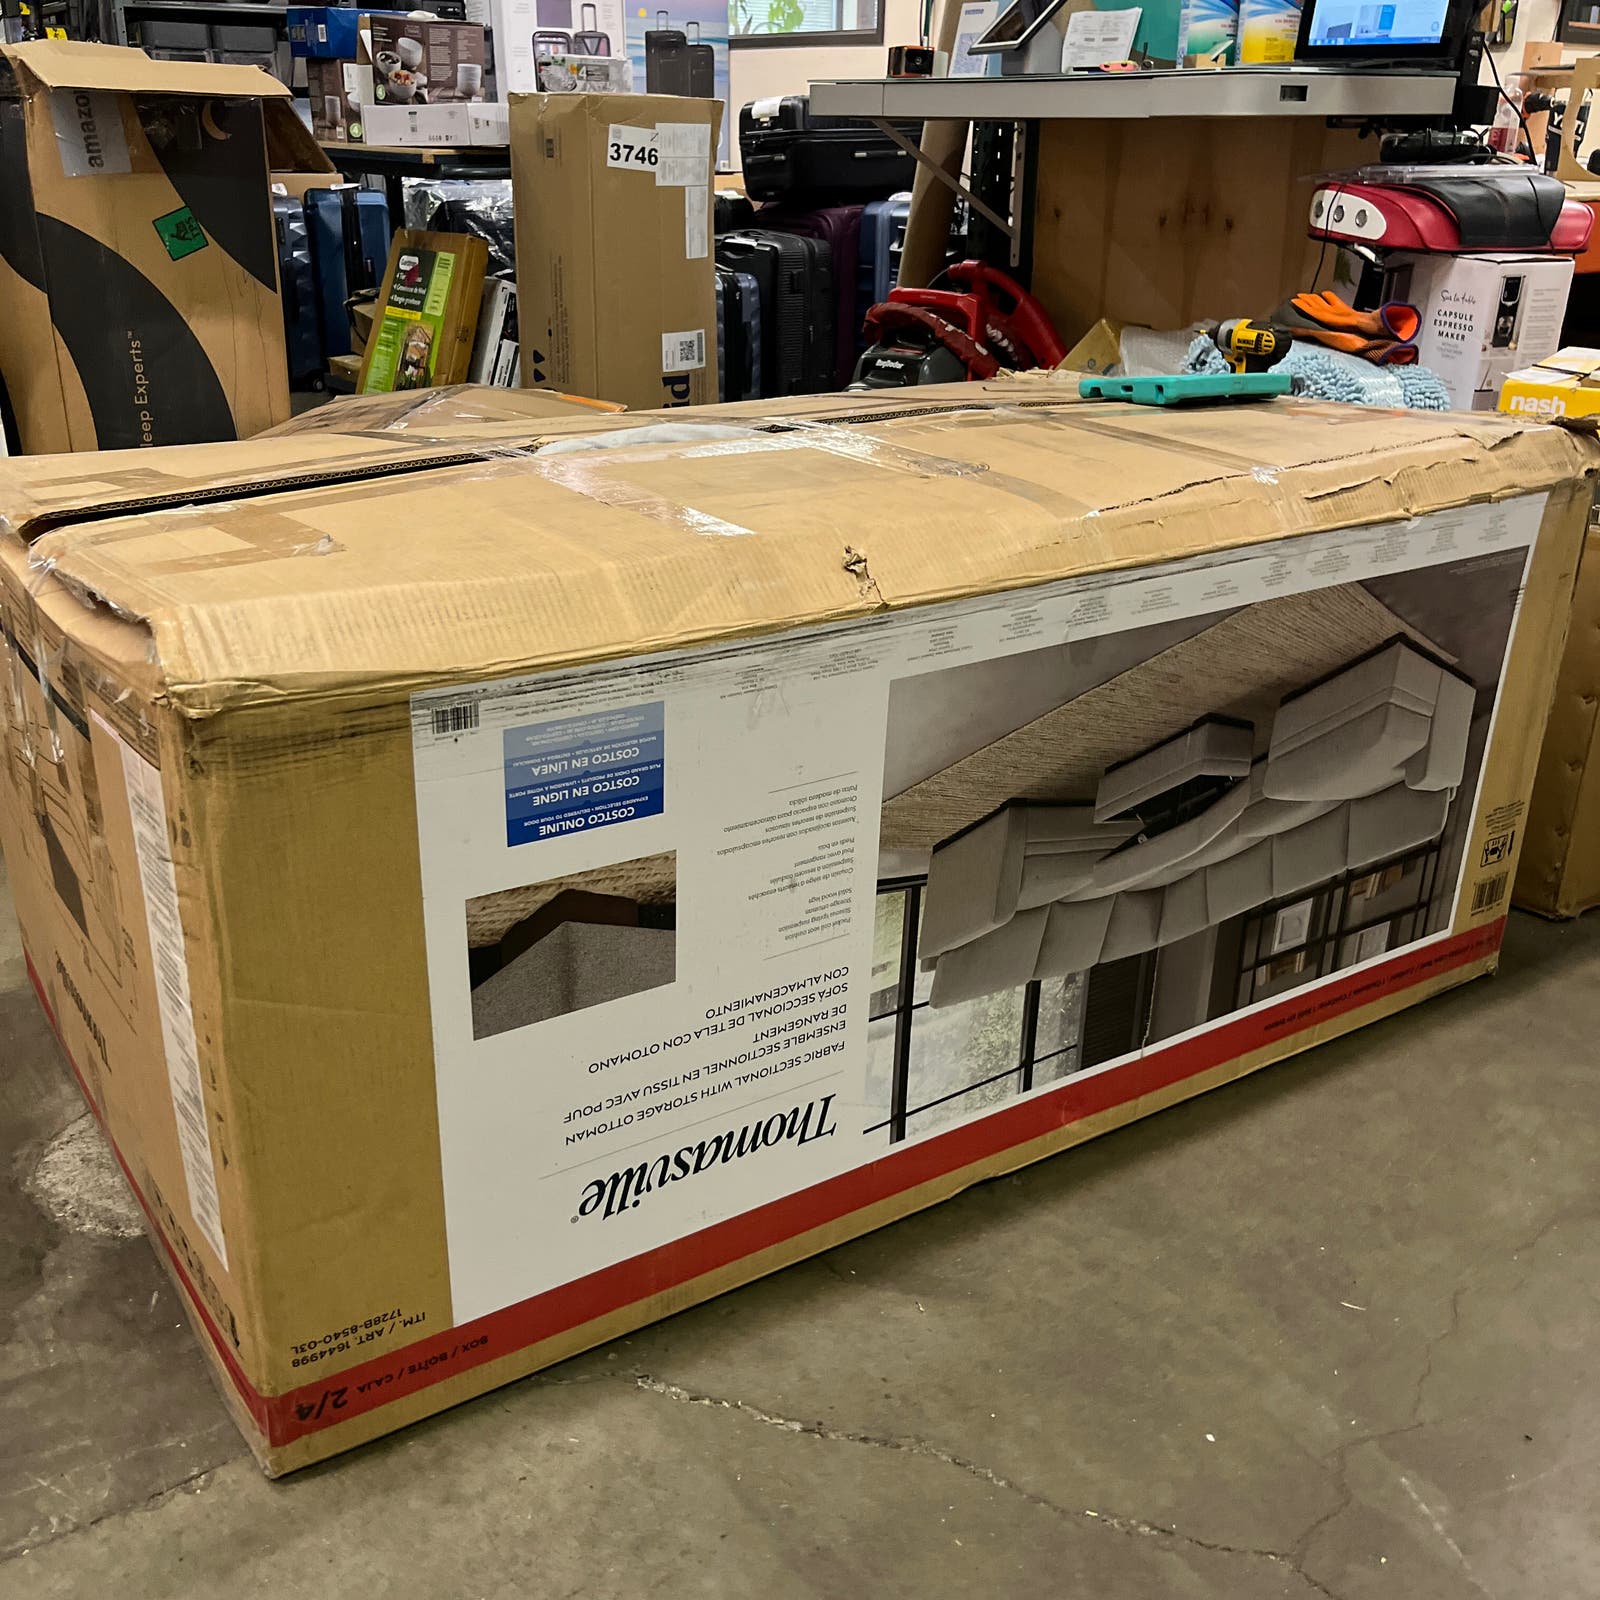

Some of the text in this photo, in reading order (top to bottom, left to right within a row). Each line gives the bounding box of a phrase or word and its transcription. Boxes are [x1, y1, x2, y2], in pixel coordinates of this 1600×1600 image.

[609, 142, 659, 166] 3746
[1434, 319, 1473, 332] ESPRESSO
[1437, 308, 1473, 321] CAPSULE
[1438, 330, 1466, 341] MAKER
[661, 374, 690, 408] id
[1509, 394, 1566, 415] nash
[139, 410, 154, 446] leep
[531, 746, 639, 776] COSTCO EN LÍNEA
[532, 775, 639, 806] COSTCO EN LIGNE
[538, 806, 634, 835] COSTCO ONLINE
[705, 966, 848, 1019] CON ALMACENAMIENTO
[588, 982, 848, 1073] SOFÁ SECCIONAL DE TELA CON OTOMANO
[752, 1003, 846, 1043] DE RANGEMENT
[563, 1019, 845, 1123] ENSEMBLE SECTIONNEL EN TISSU AVEC POUF
[565, 1040, 844, 1145] FABRIC SECTIONAL WITH STORAGE OTTOMAN
[290, 1308, 402, 1354] 1728B-8540-03L
[399, 1311, 425, 1327] ITM.
[354, 1326, 384, 1345] ART.
[461, 1335, 488, 1352] BOX
[291, 1340, 350, 1367] 1644998
[407, 1351, 448, 1374] BOÎTE
[356, 1373, 393, 1393] CAJA
[295, 1386, 348, 1421] 2/4
